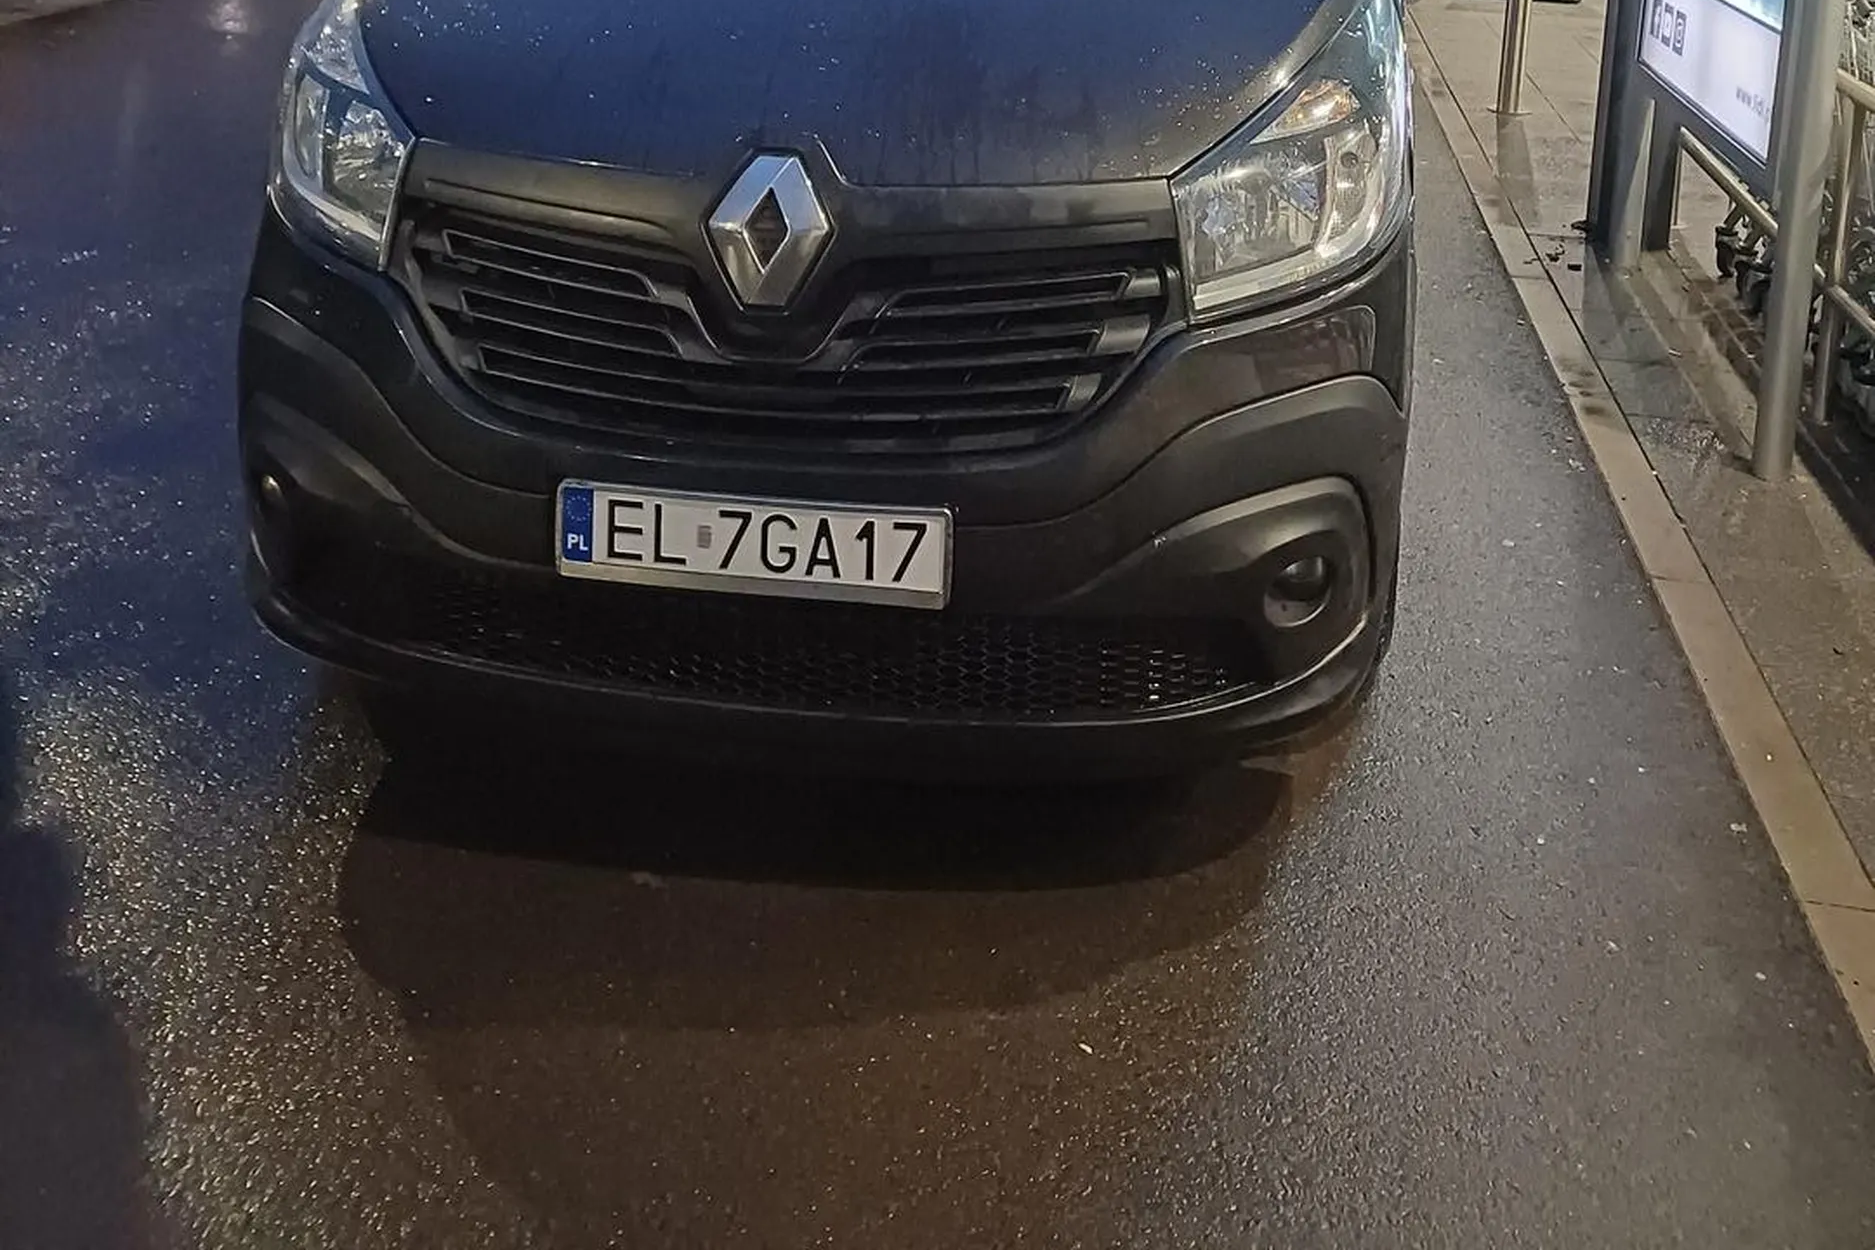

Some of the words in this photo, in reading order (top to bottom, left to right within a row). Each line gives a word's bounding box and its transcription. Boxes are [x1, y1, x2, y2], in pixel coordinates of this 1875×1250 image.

[567, 532, 589, 551] PL
[606, 498, 687, 566] EL
[718, 508, 929, 584] 7GA17
